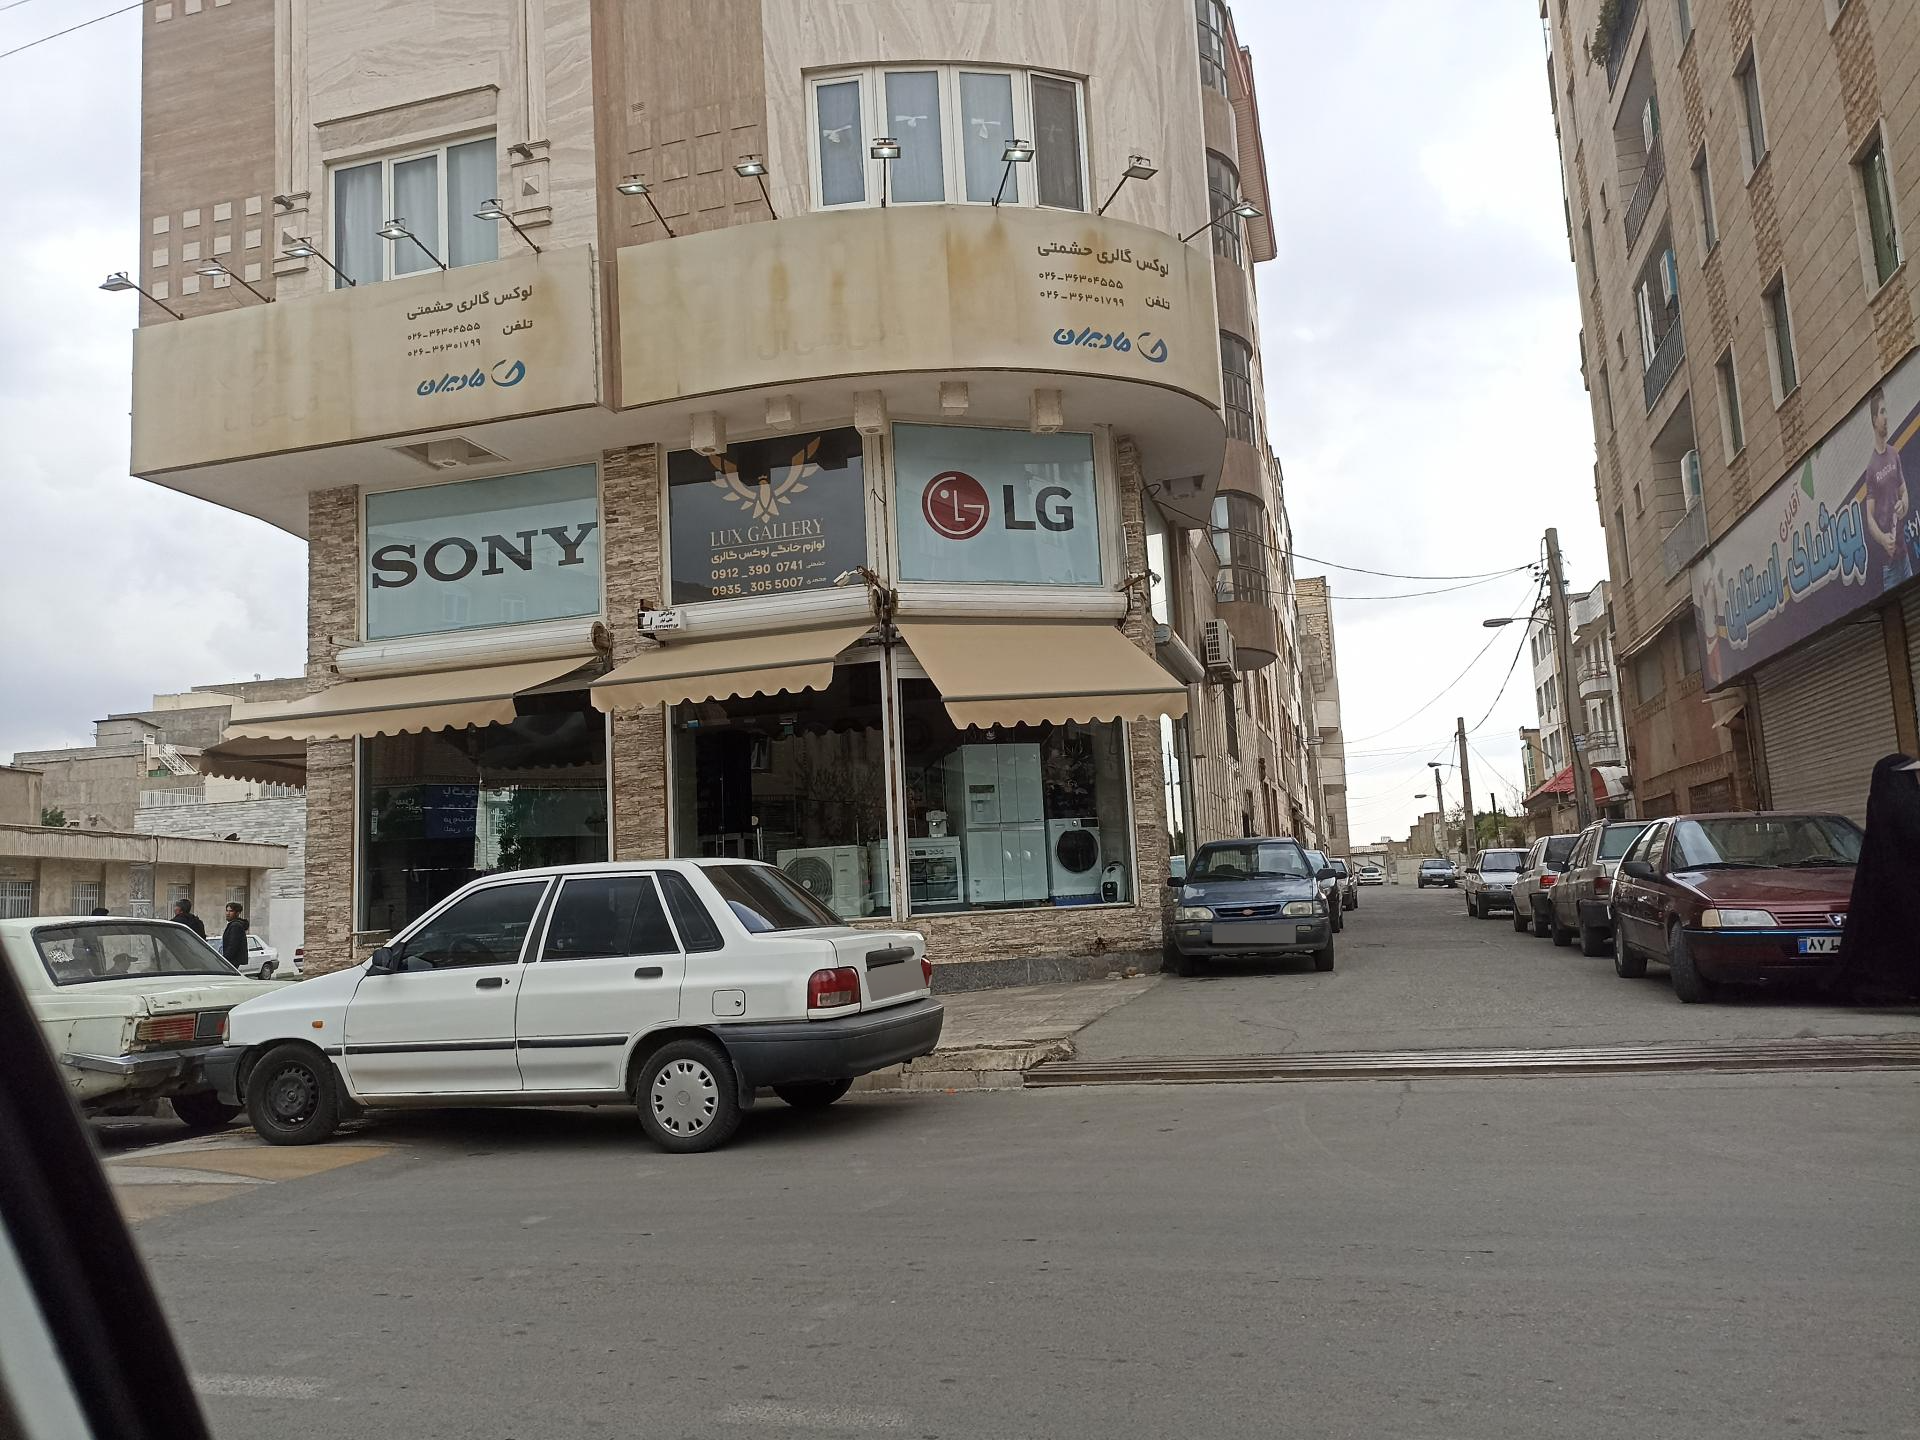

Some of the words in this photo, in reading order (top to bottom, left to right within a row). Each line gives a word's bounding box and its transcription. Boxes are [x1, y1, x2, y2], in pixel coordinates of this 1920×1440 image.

[1037, 241, 1093, 256] حشمتی
[1097, 249, 1132, 264] گالری
[1136, 259, 1169, 277] لوکس
[457, 291, 490, 313] گالری
[494, 285, 533, 306] لوکس
[1144, 296, 1171, 310] تلفن
[407, 301, 454, 320] حشمتی
[502, 319, 533, 335] تلفن
[1053, 326, 1132, 352] مادیران
[417, 368, 486, 395] مادیران
[1002, 484, 1075, 532] LG
[1779, 481, 1801, 542] آقایان
[710, 527, 743, 547] LUX
[747, 518, 824, 543] GALLERY
[371, 521, 598, 589] SONY
[711, 550, 738, 564] گالری
[739, 546, 770, 561] لوکس
[802, 540, 826, 554] لوازم
[1787, 500, 1868, 597] پوشاک
[711, 567, 739, 580] 0912
[775, 560, 803, 573] 0741
[750, 581, 772, 592] 305
[775, 577, 804, 589] 5007
[1724, 541, 1784, 645] استایل
